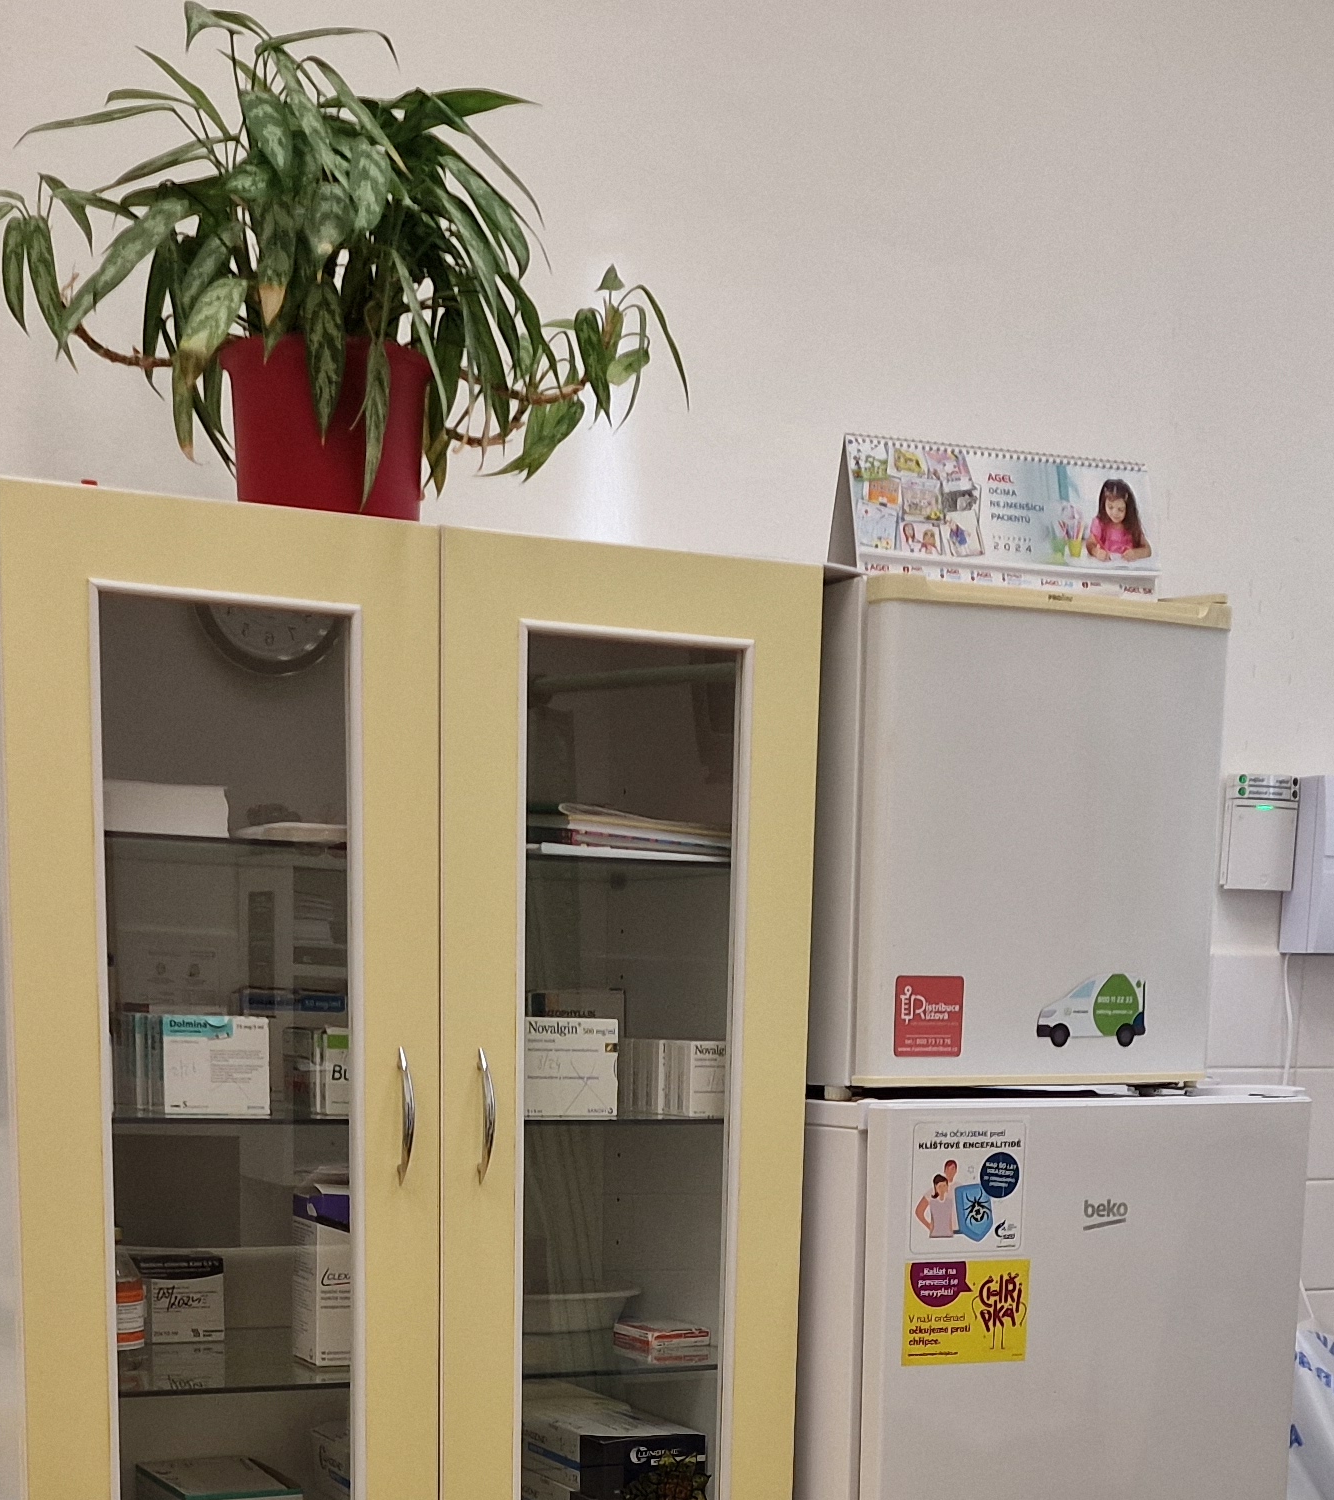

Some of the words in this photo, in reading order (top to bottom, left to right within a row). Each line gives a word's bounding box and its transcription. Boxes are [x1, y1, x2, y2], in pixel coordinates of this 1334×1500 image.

[987, 473, 1014, 484] AGEL
[988, 487, 1017, 497] OČIMA
[990, 512, 1031, 524] PACIENTŮ
[993, 541, 1033, 553] 2024
[169, 1019, 207, 1029] Dolmina
[528, 1020, 579, 1037] Novalgin
[918, 1140, 961, 1150] KLÍŠŤOVÉ
[1083, 1199, 1128, 1218] beko
[908, 1314, 916, 1323] V
[950, 1323, 971, 1335] proti
